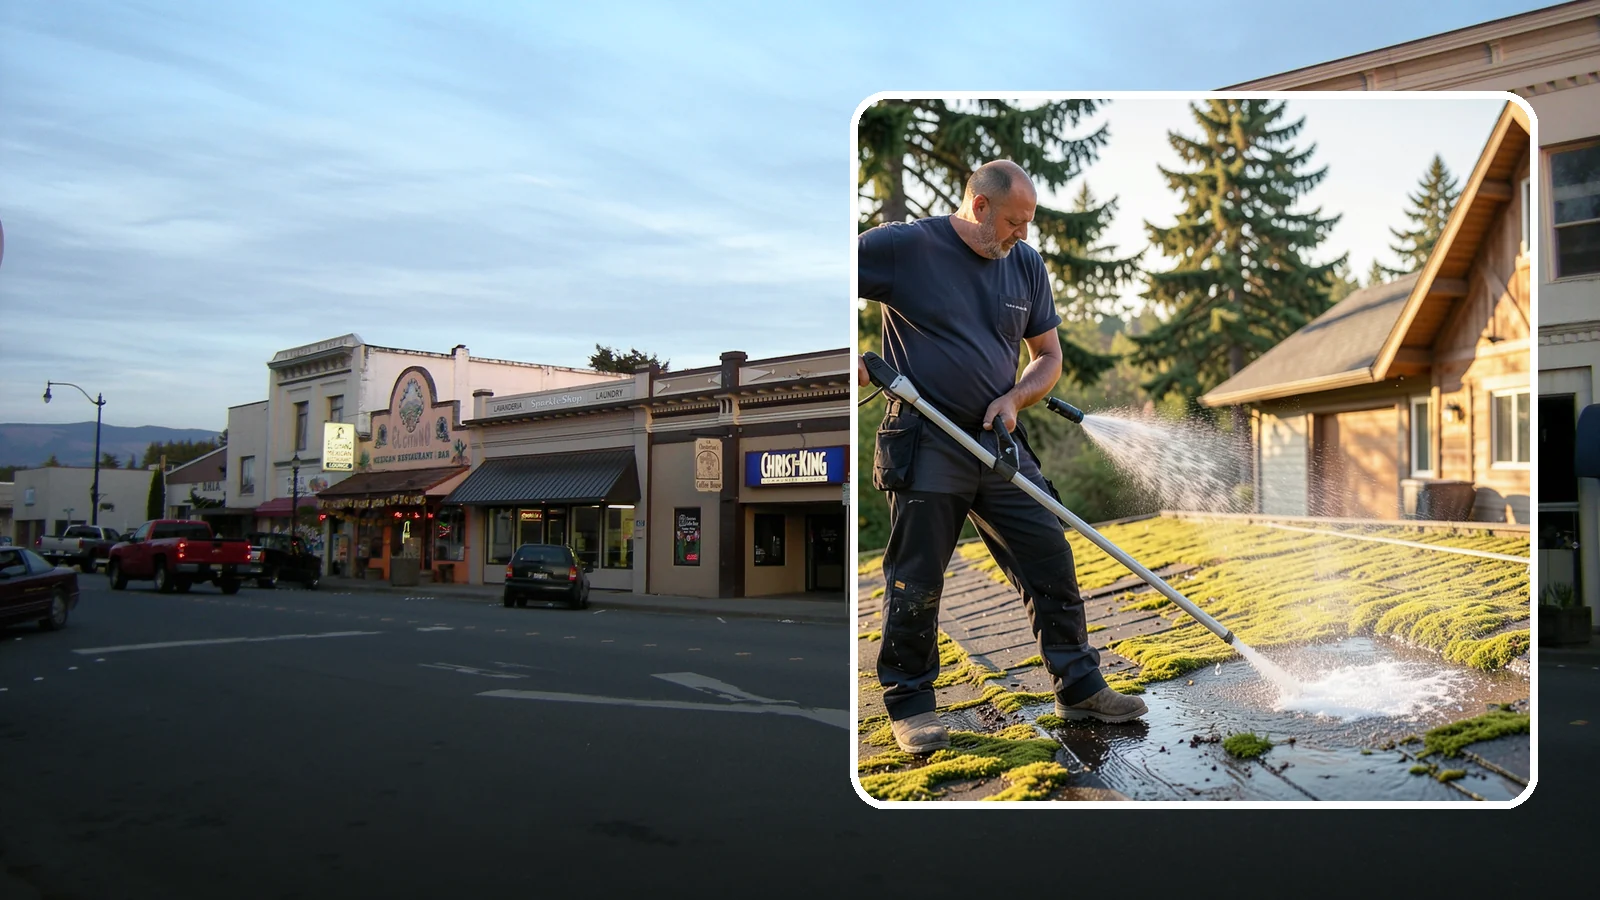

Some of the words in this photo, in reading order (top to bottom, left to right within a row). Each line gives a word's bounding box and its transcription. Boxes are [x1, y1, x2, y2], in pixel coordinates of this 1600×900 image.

[561, 394, 582, 405] Shop
[595, 389, 623, 400] LAUNDRY
[493, 402, 523, 413] LAVANDERIA
[392, 426, 401, 449] EL
[373, 454, 396, 464] MEXICAN
[397, 451, 433, 462] RESTAURANT
[437, 449, 450, 459] BAR
[760, 452, 797, 478] CHRIST
[799, 450, 827, 476] KING
[696, 480, 709, 489] Coffee
[710, 480, 722, 489] House
